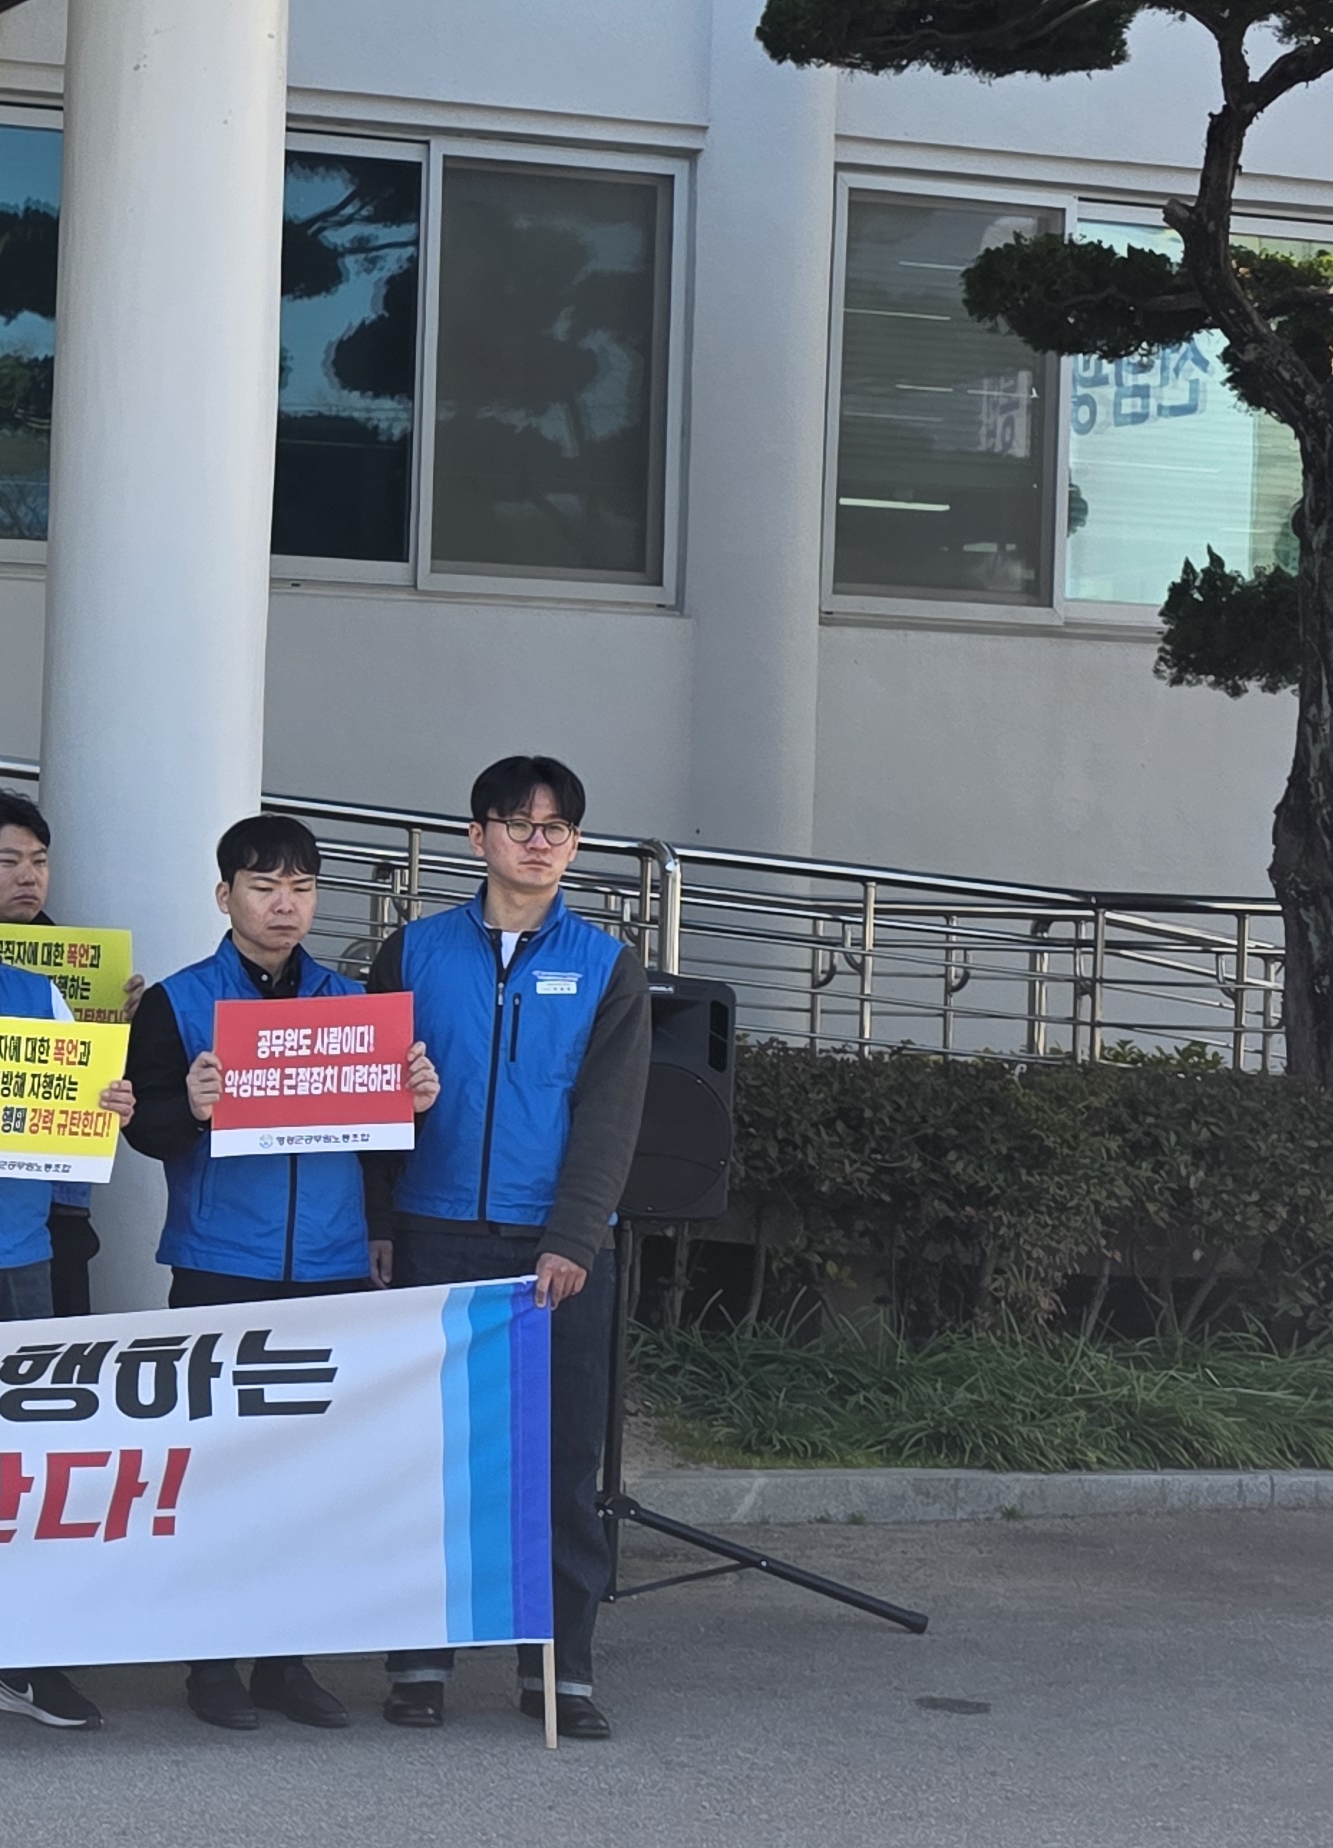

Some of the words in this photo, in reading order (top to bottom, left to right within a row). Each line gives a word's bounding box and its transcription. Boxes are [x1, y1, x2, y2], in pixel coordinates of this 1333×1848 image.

[41, 942, 65, 967] 대한
[67, 942, 101, 969] 폭언과
[24, 1036, 51, 1065] 대한
[53, 1039, 92, 1067] 폭언과
[257, 1028, 312, 1059] 공무원도
[314, 1024, 375, 1056] 사람이다!
[28, 1073, 79, 1102] 자행하는
[224, 1068, 280, 1099] 악성민원
[283, 1065, 337, 1097] 근절장치
[340, 1062, 402, 1095] 마련하라!
[1, 1106, 27, 1134] 행태
[29, 1108, 54, 1136] 강력
[56, 1110, 112, 1139] 규탄한다!
